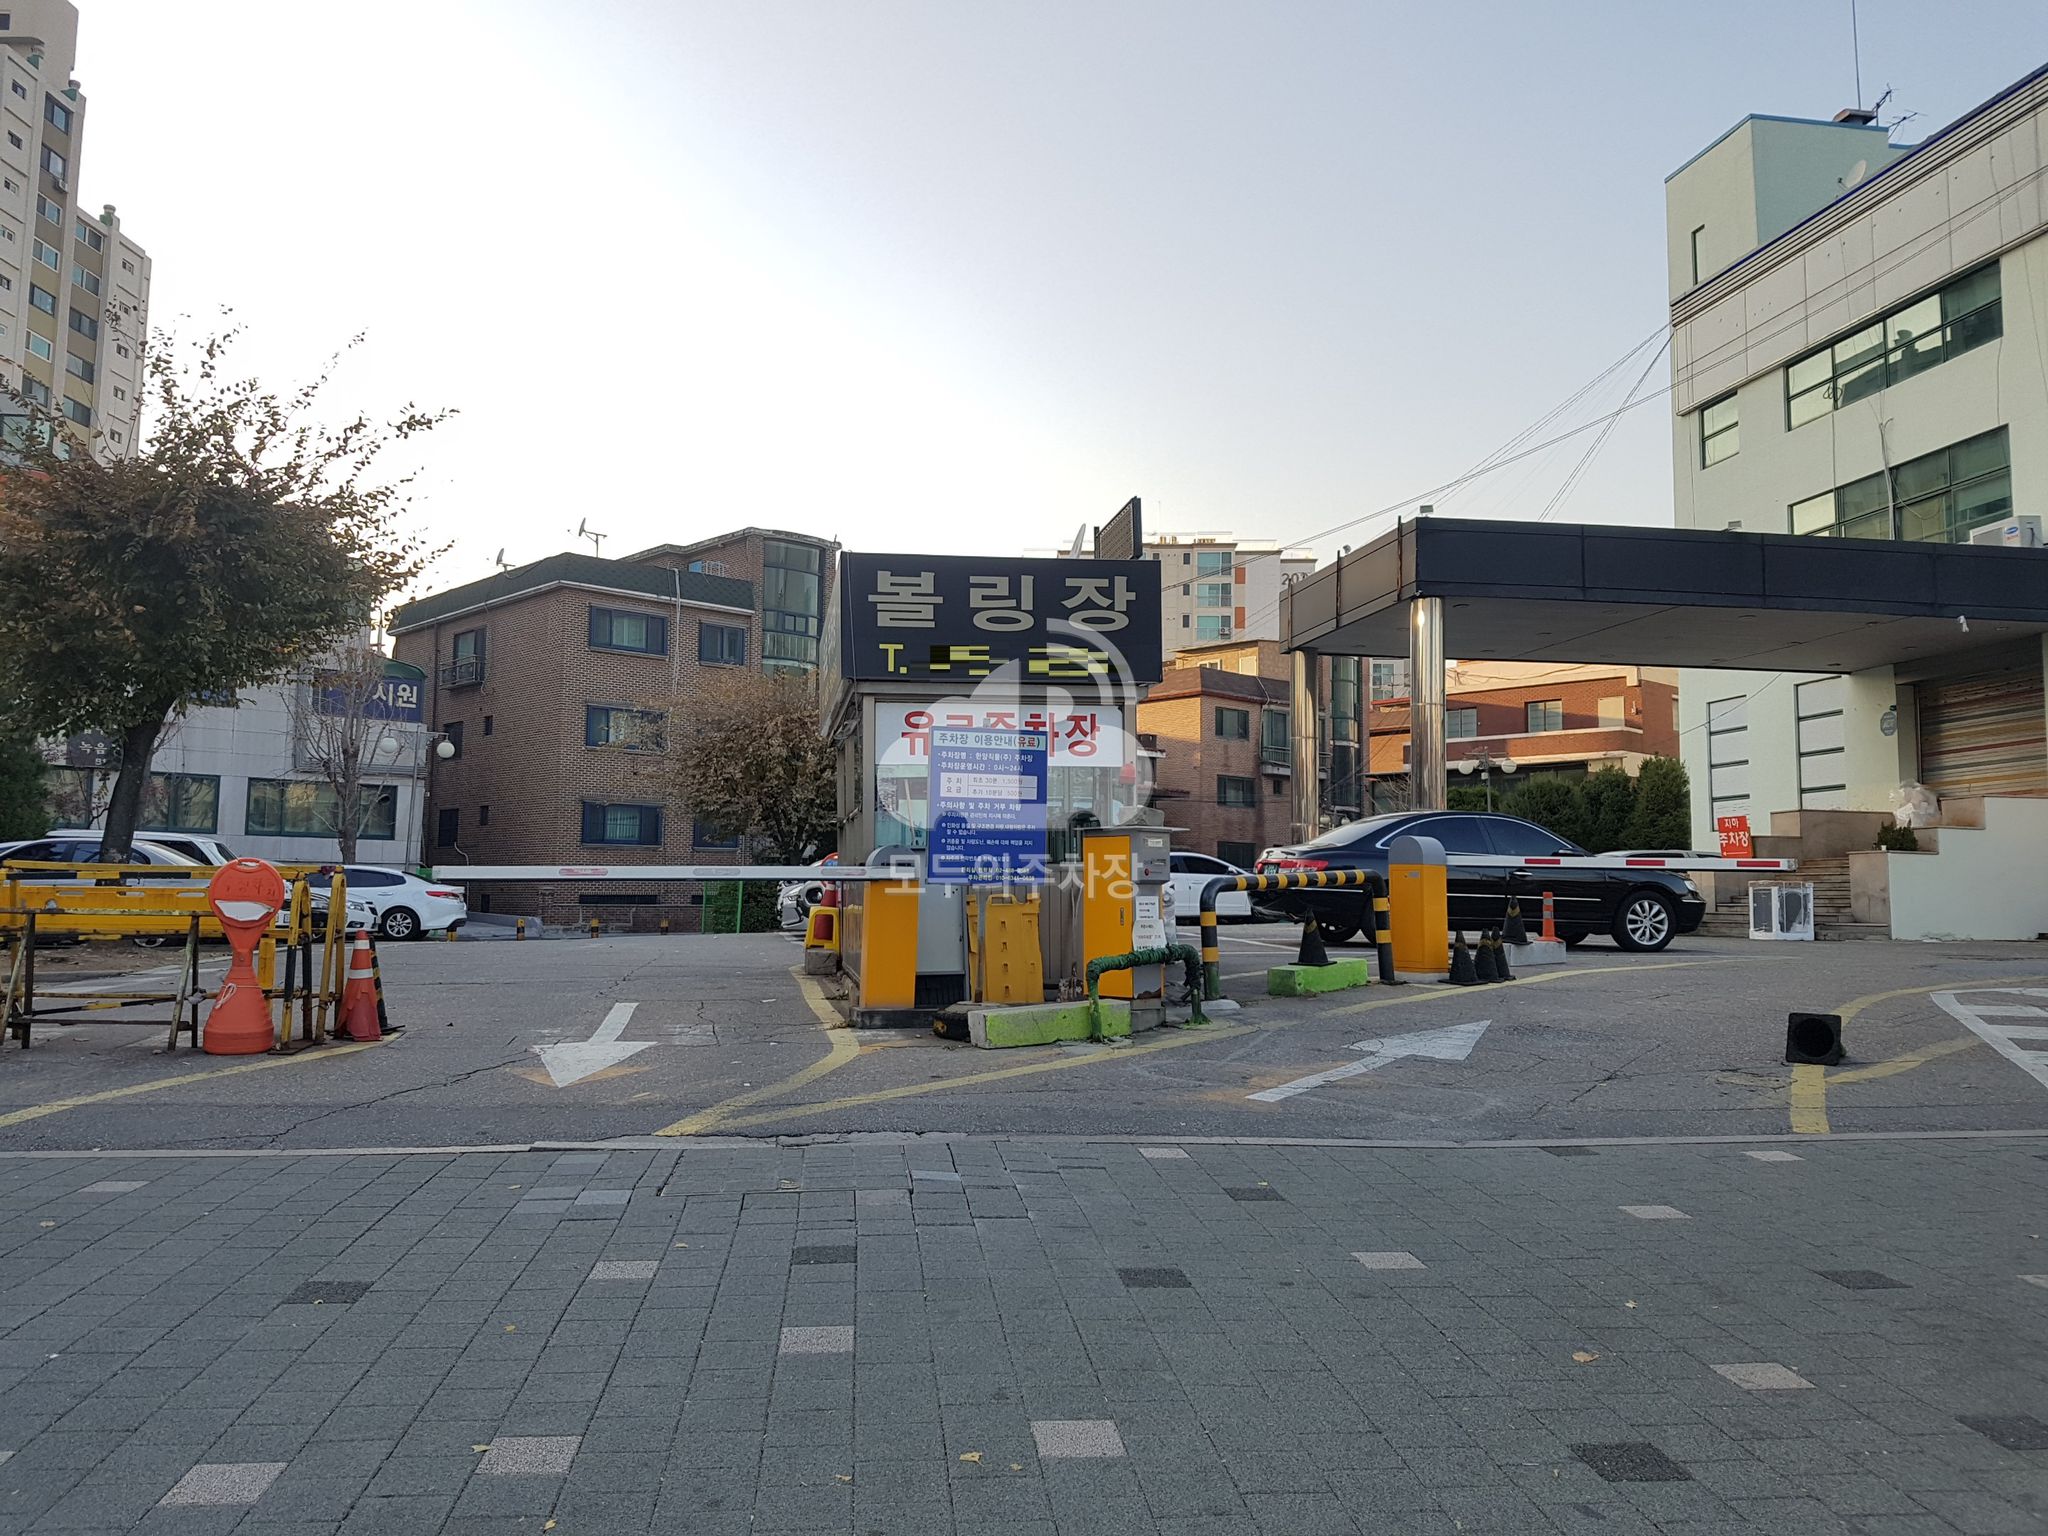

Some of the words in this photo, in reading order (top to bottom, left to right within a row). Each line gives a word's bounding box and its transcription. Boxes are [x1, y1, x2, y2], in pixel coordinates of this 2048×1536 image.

[867, 570, 1137, 632] 볼링장
[939, 732, 969, 745] 주차장
[974, 734, 1041, 749] 이용안내(유료)
[1720, 831, 1749, 847] 주차장
